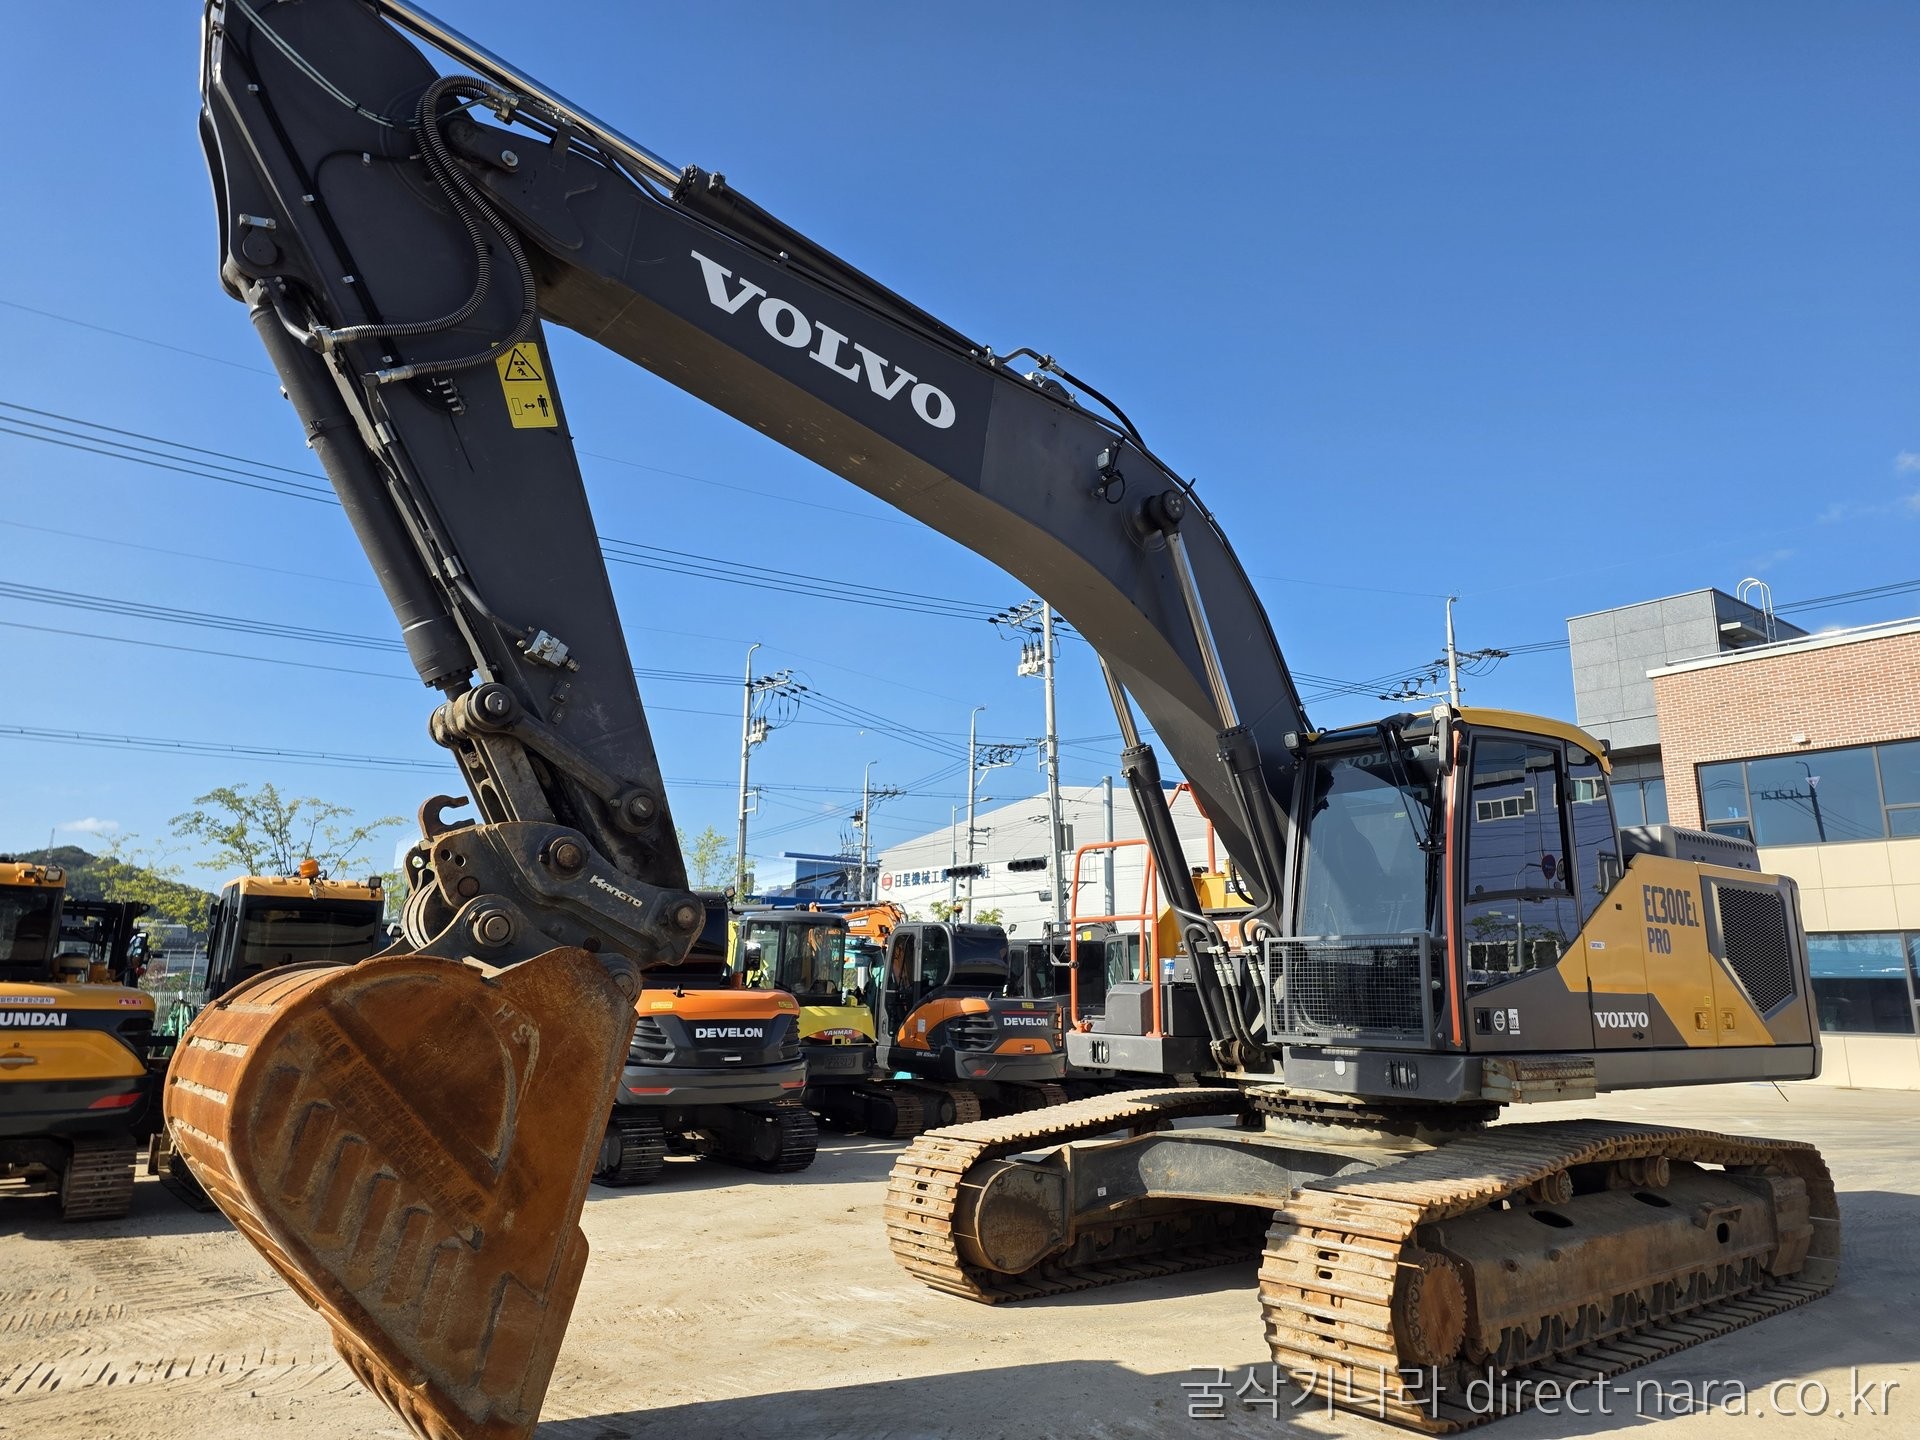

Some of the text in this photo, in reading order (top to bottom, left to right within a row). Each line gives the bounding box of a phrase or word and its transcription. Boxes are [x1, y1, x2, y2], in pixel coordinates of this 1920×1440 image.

[691, 249, 956, 429] VOLVO
[1647, 926, 1671, 955] PRO
[1003, 1017, 1048, 1026] DEVELON
[1594, 1011, 1649, 1029] VOLVO
[695, 1027, 763, 1039] DEVELON
